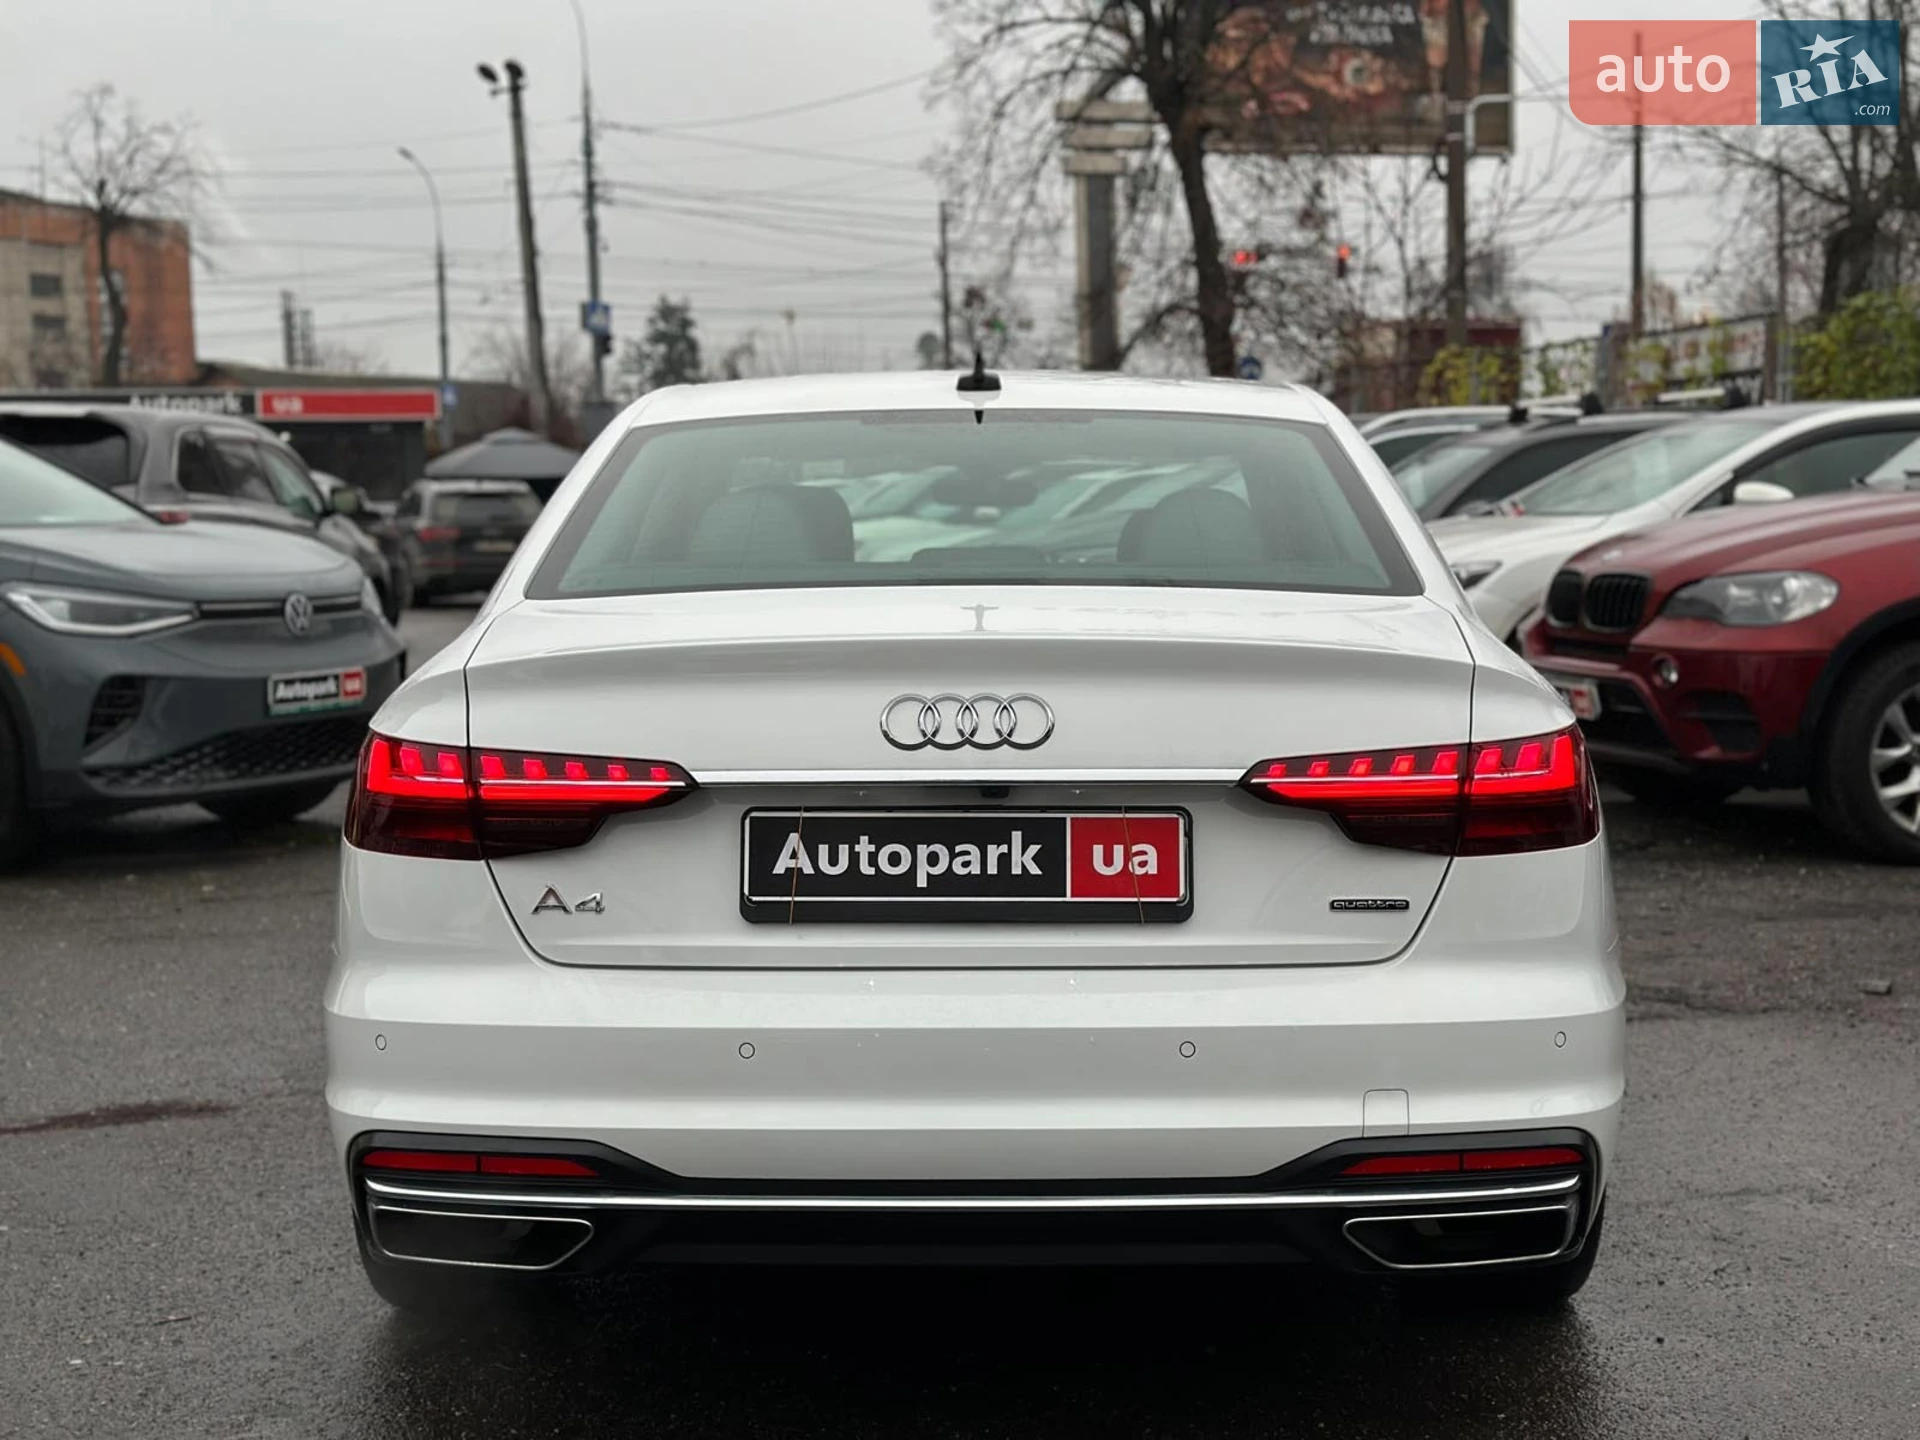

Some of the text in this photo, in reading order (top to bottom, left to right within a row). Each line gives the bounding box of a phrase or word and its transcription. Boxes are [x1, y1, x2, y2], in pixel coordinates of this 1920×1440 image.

[772, 830, 1158, 888] Autopark ua
[531, 884, 605, 914] A4
[1333, 900, 1407, 911] quattro
